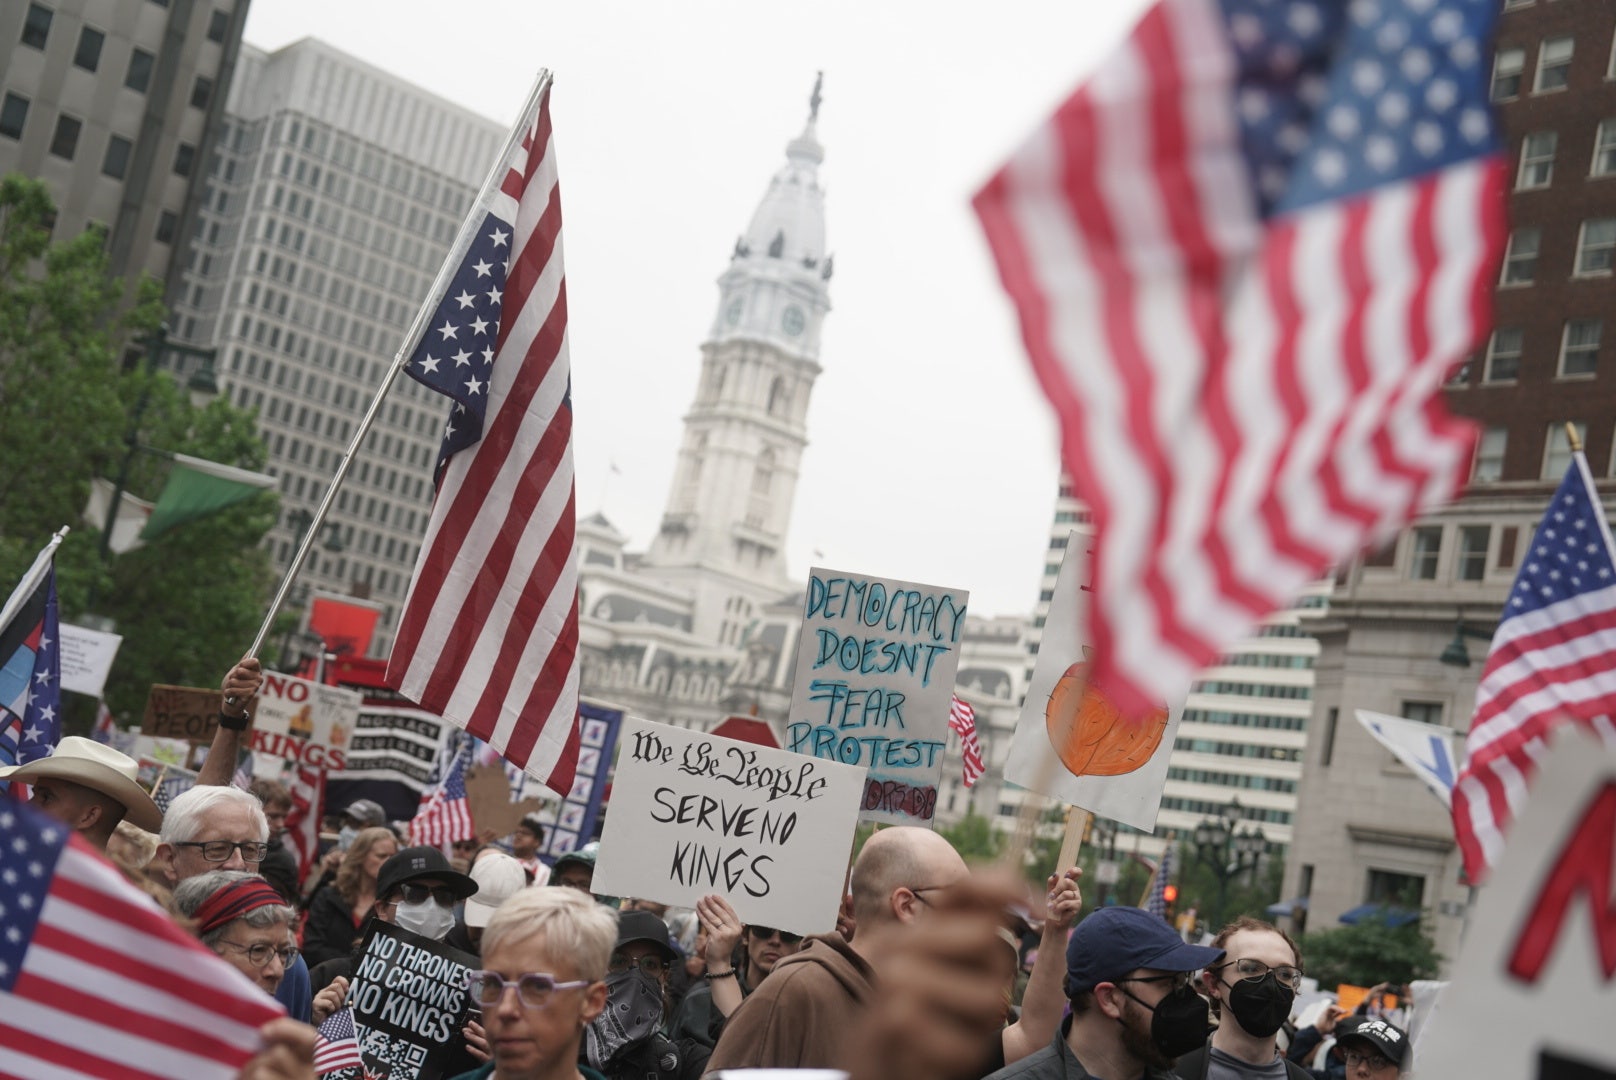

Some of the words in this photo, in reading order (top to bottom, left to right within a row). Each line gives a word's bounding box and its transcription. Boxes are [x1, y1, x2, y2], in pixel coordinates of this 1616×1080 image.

[807, 575, 967, 643] DEMOCRACY
[816, 628, 952, 683] DOESN'T
[262, 675, 309, 703] NO
[809, 682, 906, 730] FEAR
[153, 712, 219, 737] PEOP
[250, 729, 346, 771] KINGS
[787, 722, 947, 768] PROTEST
[631, 729, 674, 766] We
[715, 746, 828, 803] People
[650, 787, 759, 837] SERVE
[759, 810, 797, 846] NO
[670, 840, 774, 897] KINGS
[356, 954, 387, 983] NO
[384, 966, 465, 1014] CROWNS
[367, 931, 397, 960] NO
[395, 941, 474, 991] THRONES
[344, 977, 382, 1015] NO
[379, 991, 455, 1043] KINGS
[1372, 1030, 1389, 1043] YORK
